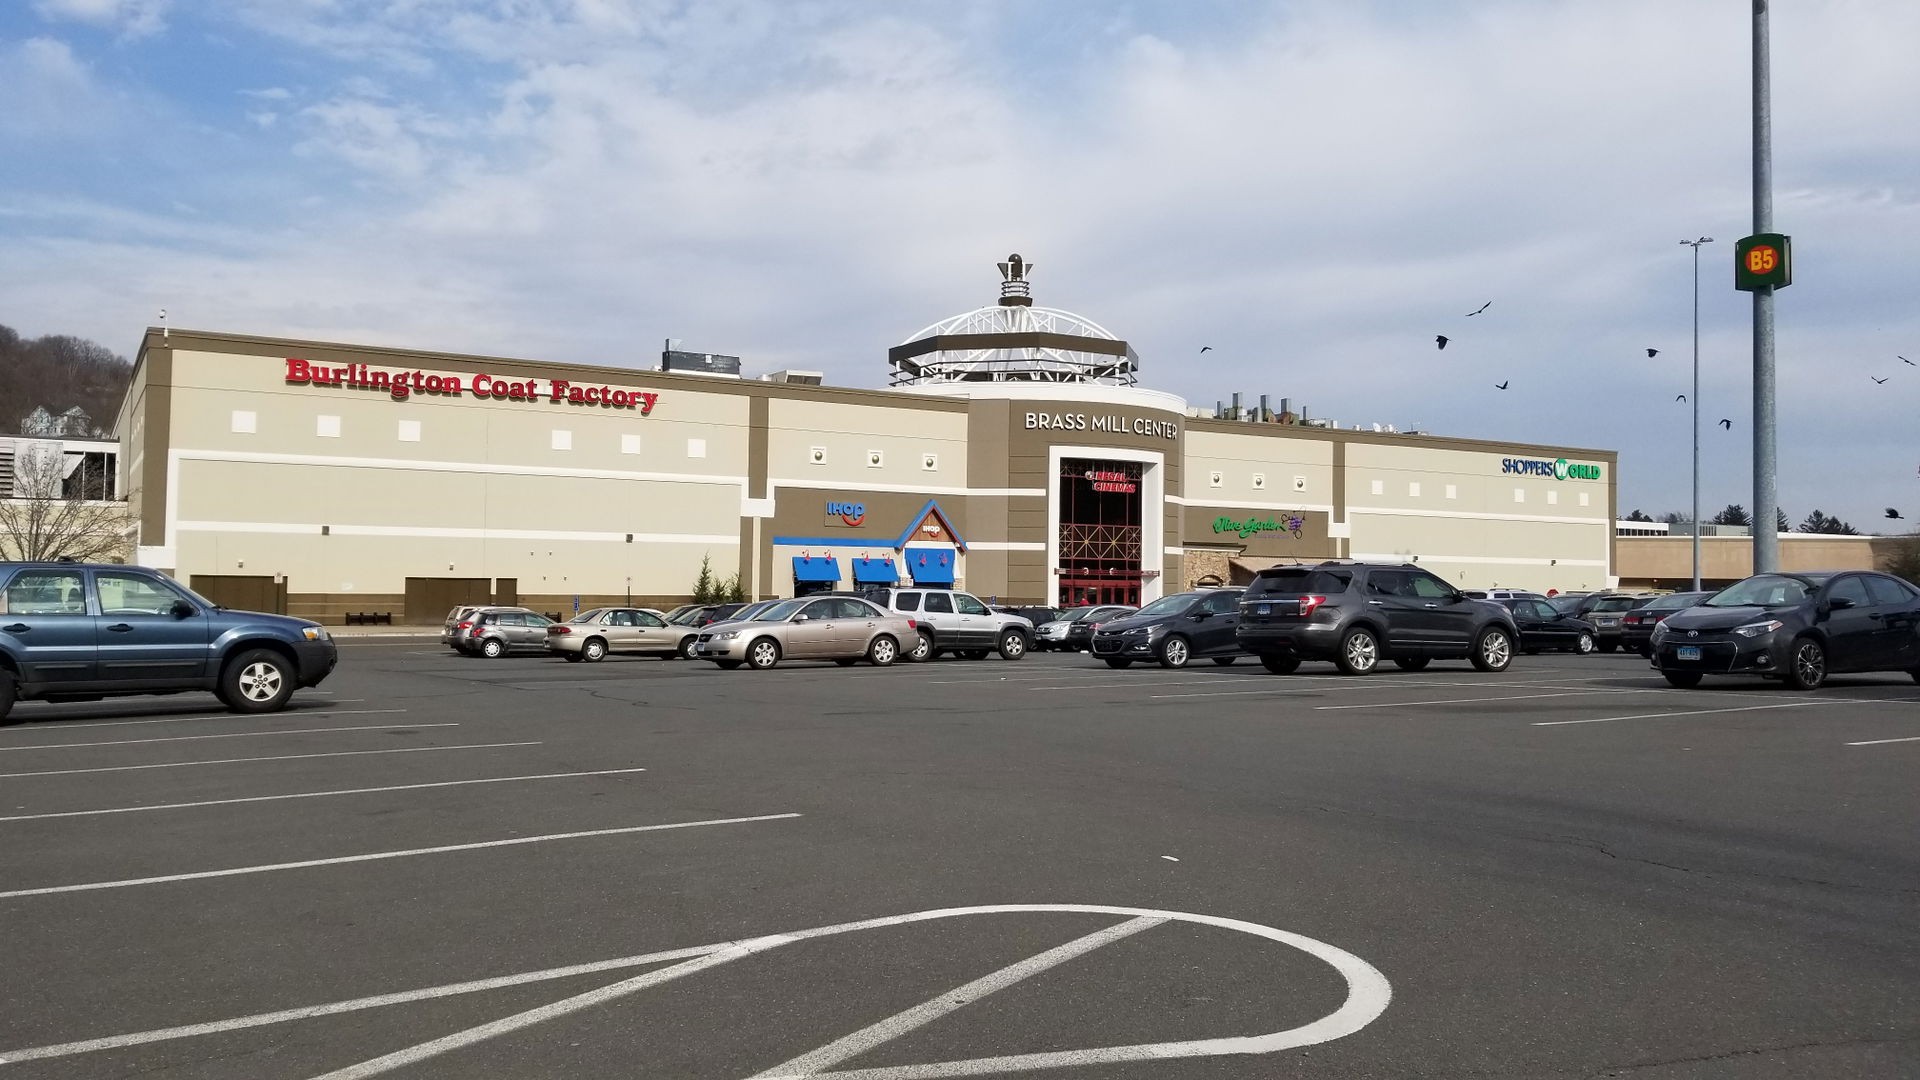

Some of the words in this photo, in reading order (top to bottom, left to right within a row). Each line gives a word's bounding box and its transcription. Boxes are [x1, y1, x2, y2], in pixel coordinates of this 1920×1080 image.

[1751, 249, 1774, 271] B5
[285, 358, 461, 398] Burlington
[472, 373, 539, 398] Coat
[549, 379, 659, 414] Factory
[1025, 412, 1086, 430] BRASS
[1091, 415, 1130, 433] MILL
[1133, 418, 1178, 440] CENTER
[1095, 471, 1127, 482] REGAL
[1502, 458, 1554, 477] SHOPPERS
[1555, 460, 1601, 480] WORLD
[1094, 481, 1136, 493] CINEMAS
[1213, 516, 1242, 533] Olive
[1239, 515, 1287, 538] Garden
